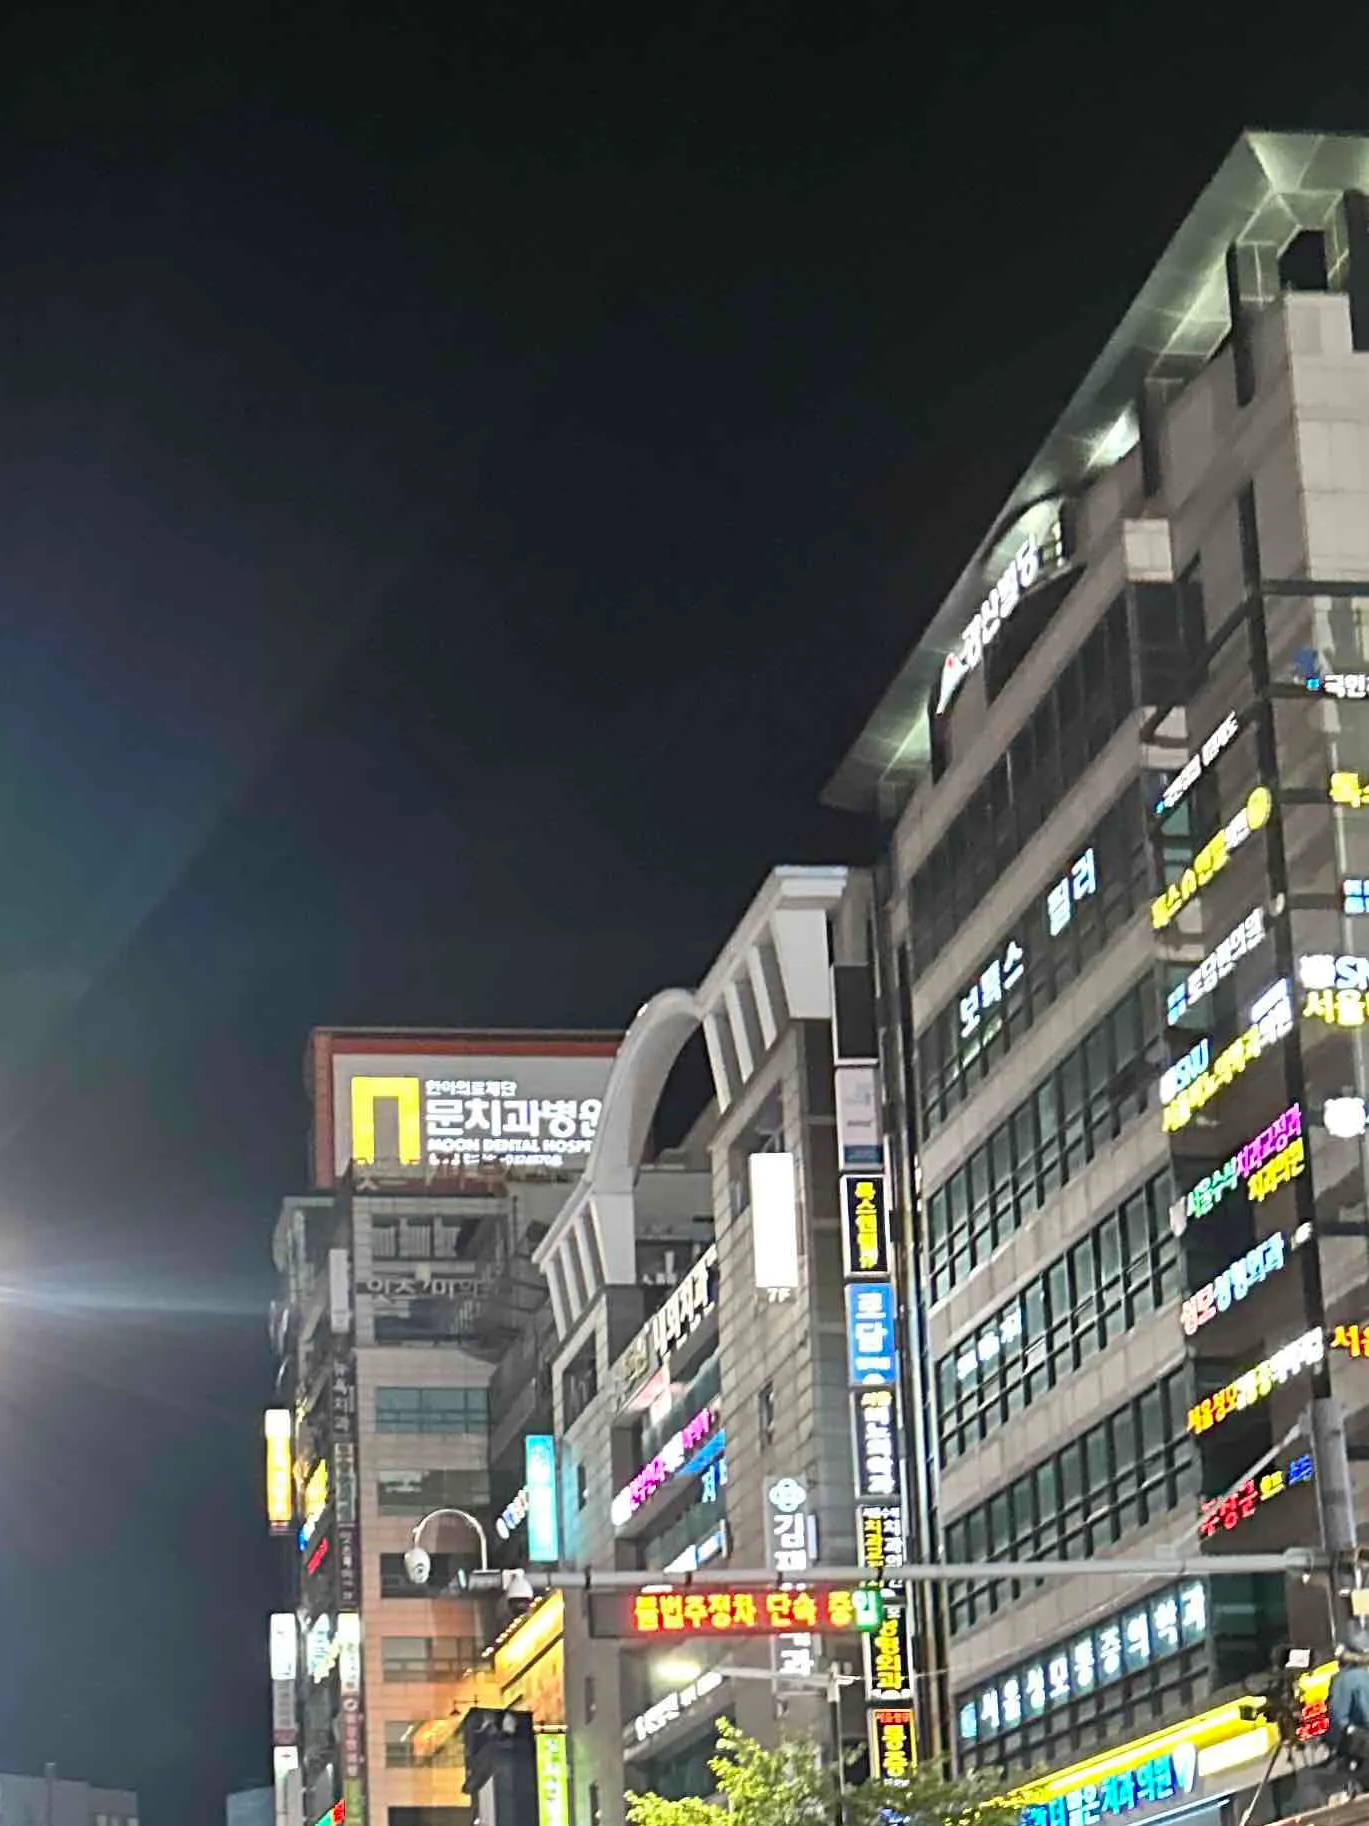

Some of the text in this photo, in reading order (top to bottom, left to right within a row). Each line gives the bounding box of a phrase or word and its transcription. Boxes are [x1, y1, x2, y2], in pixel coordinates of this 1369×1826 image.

[1302, 989, 1369, 1027] 서울
[428, 1138, 479, 1152] MOON
[483, 1138, 540, 1152] DENTAL
[635, 1593, 757, 1631] 불법주정차
[767, 1592, 816, 1628] 단속
